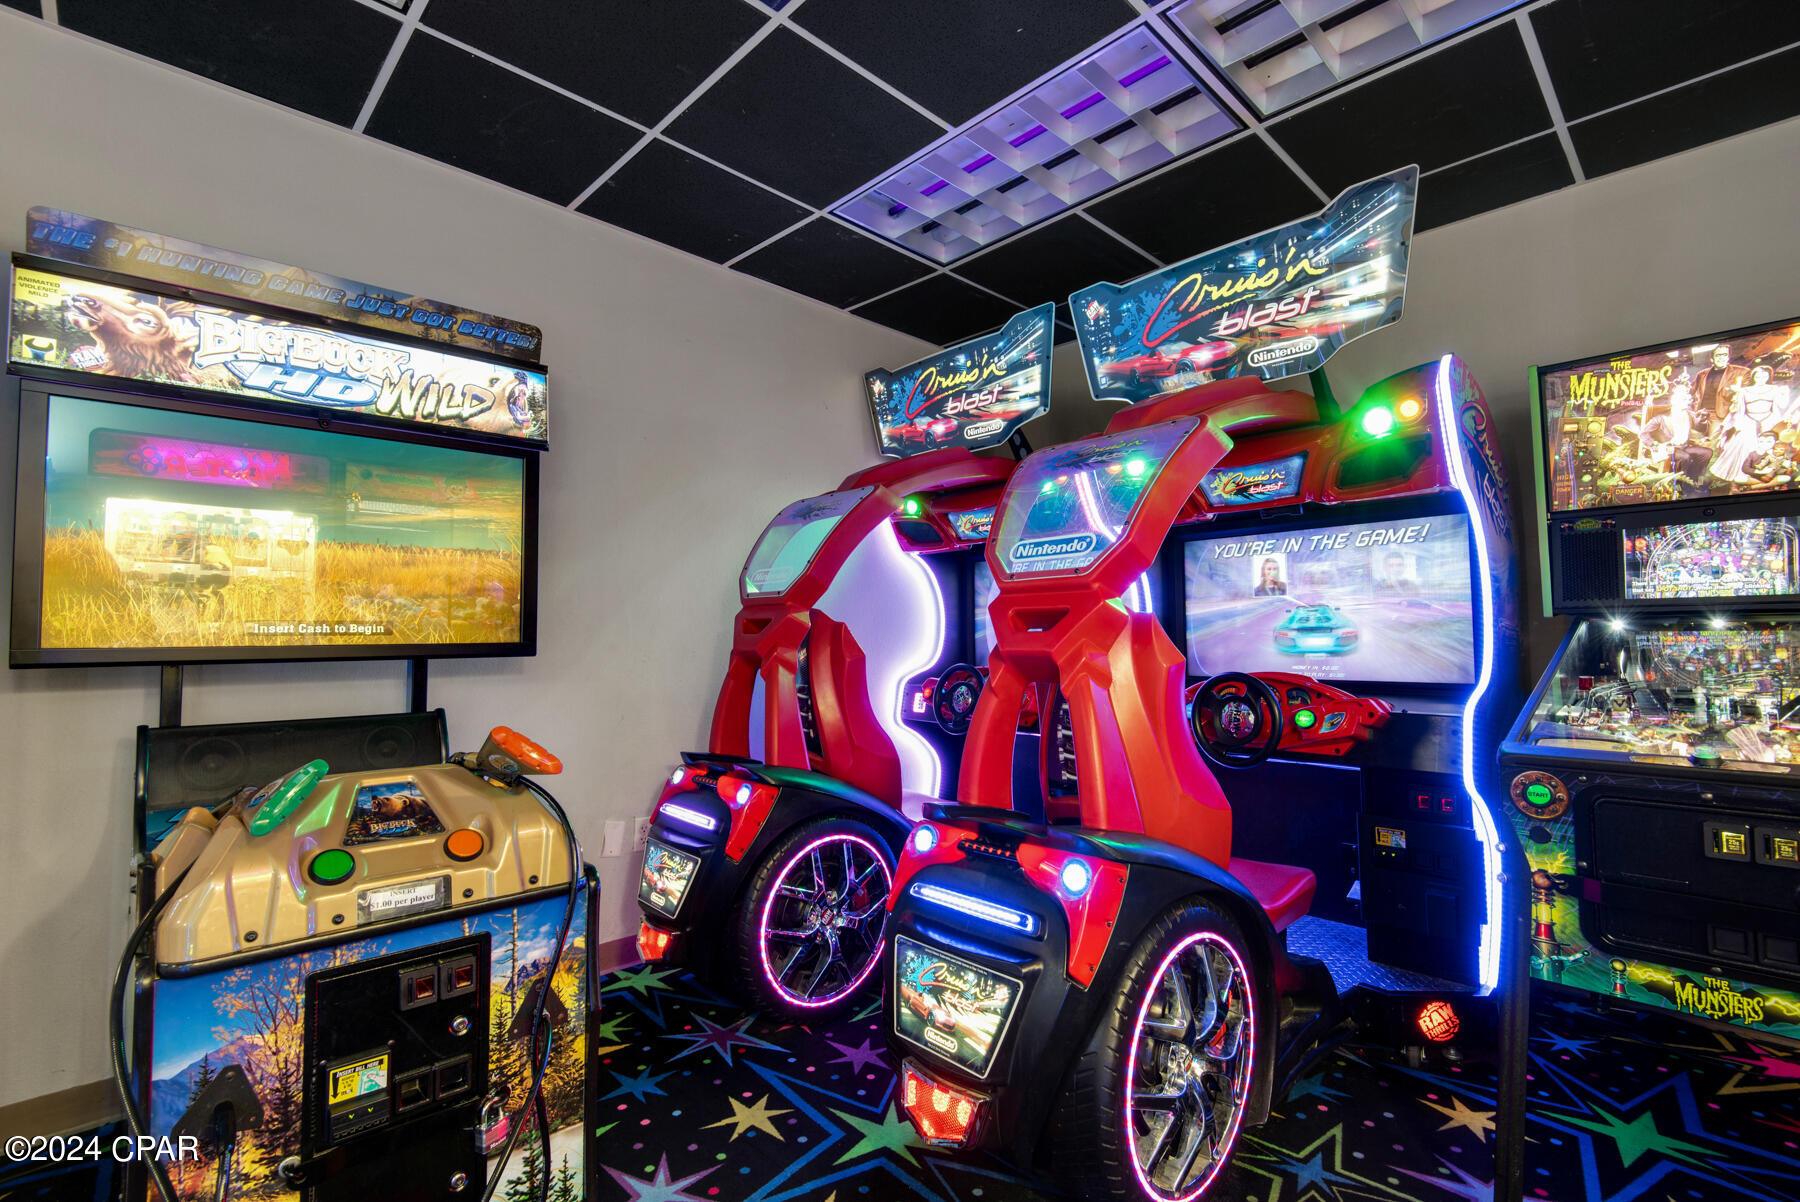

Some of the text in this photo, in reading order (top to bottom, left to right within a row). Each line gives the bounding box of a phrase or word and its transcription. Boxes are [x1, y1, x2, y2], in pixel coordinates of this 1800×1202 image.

[17, 275, 61, 289] ANIMATED
[18, 282, 58, 294] VIOLENCE
[32, 222, 539, 350] THE #1 HUNTING GAME JUST GOT BETTER!
[28, 290, 49, 298] MILD
[1217, 286, 1321, 336] blast
[192, 310, 411, 386] BIG BUCK
[1253, 342, 1312, 364] Nintendo
[1610, 360, 1632, 371] THE
[243, 362, 377, 406] HD
[1569, 365, 1673, 410] MUNSTERS
[376, 369, 497, 421] WILD
[944, 384, 1003, 415] blast
[967, 423, 1001, 437] Nintendo
[1248, 480, 1284, 494] blast
[1615, 487, 1643, 495] DANGER
[1015, 539, 1087, 558] Nintendo
[1213, 523, 1432, 559] YOU'RE IN THE GAME!
[254, 623, 385, 635] Insert Cash to Begin
[1527, 791, 1549, 799] START
[370, 821, 388, 833] BIG
[389, 819, 417, 829] BUCK
[390, 888, 416, 897] INSERT
[394, 898, 408, 908] per
[410, 894, 434, 904] player
[1703, 976, 1730, 991] THE
[1673, 980, 1764, 1025] MUNSTERS
[927, 1030, 956, 1050] Nintendo
